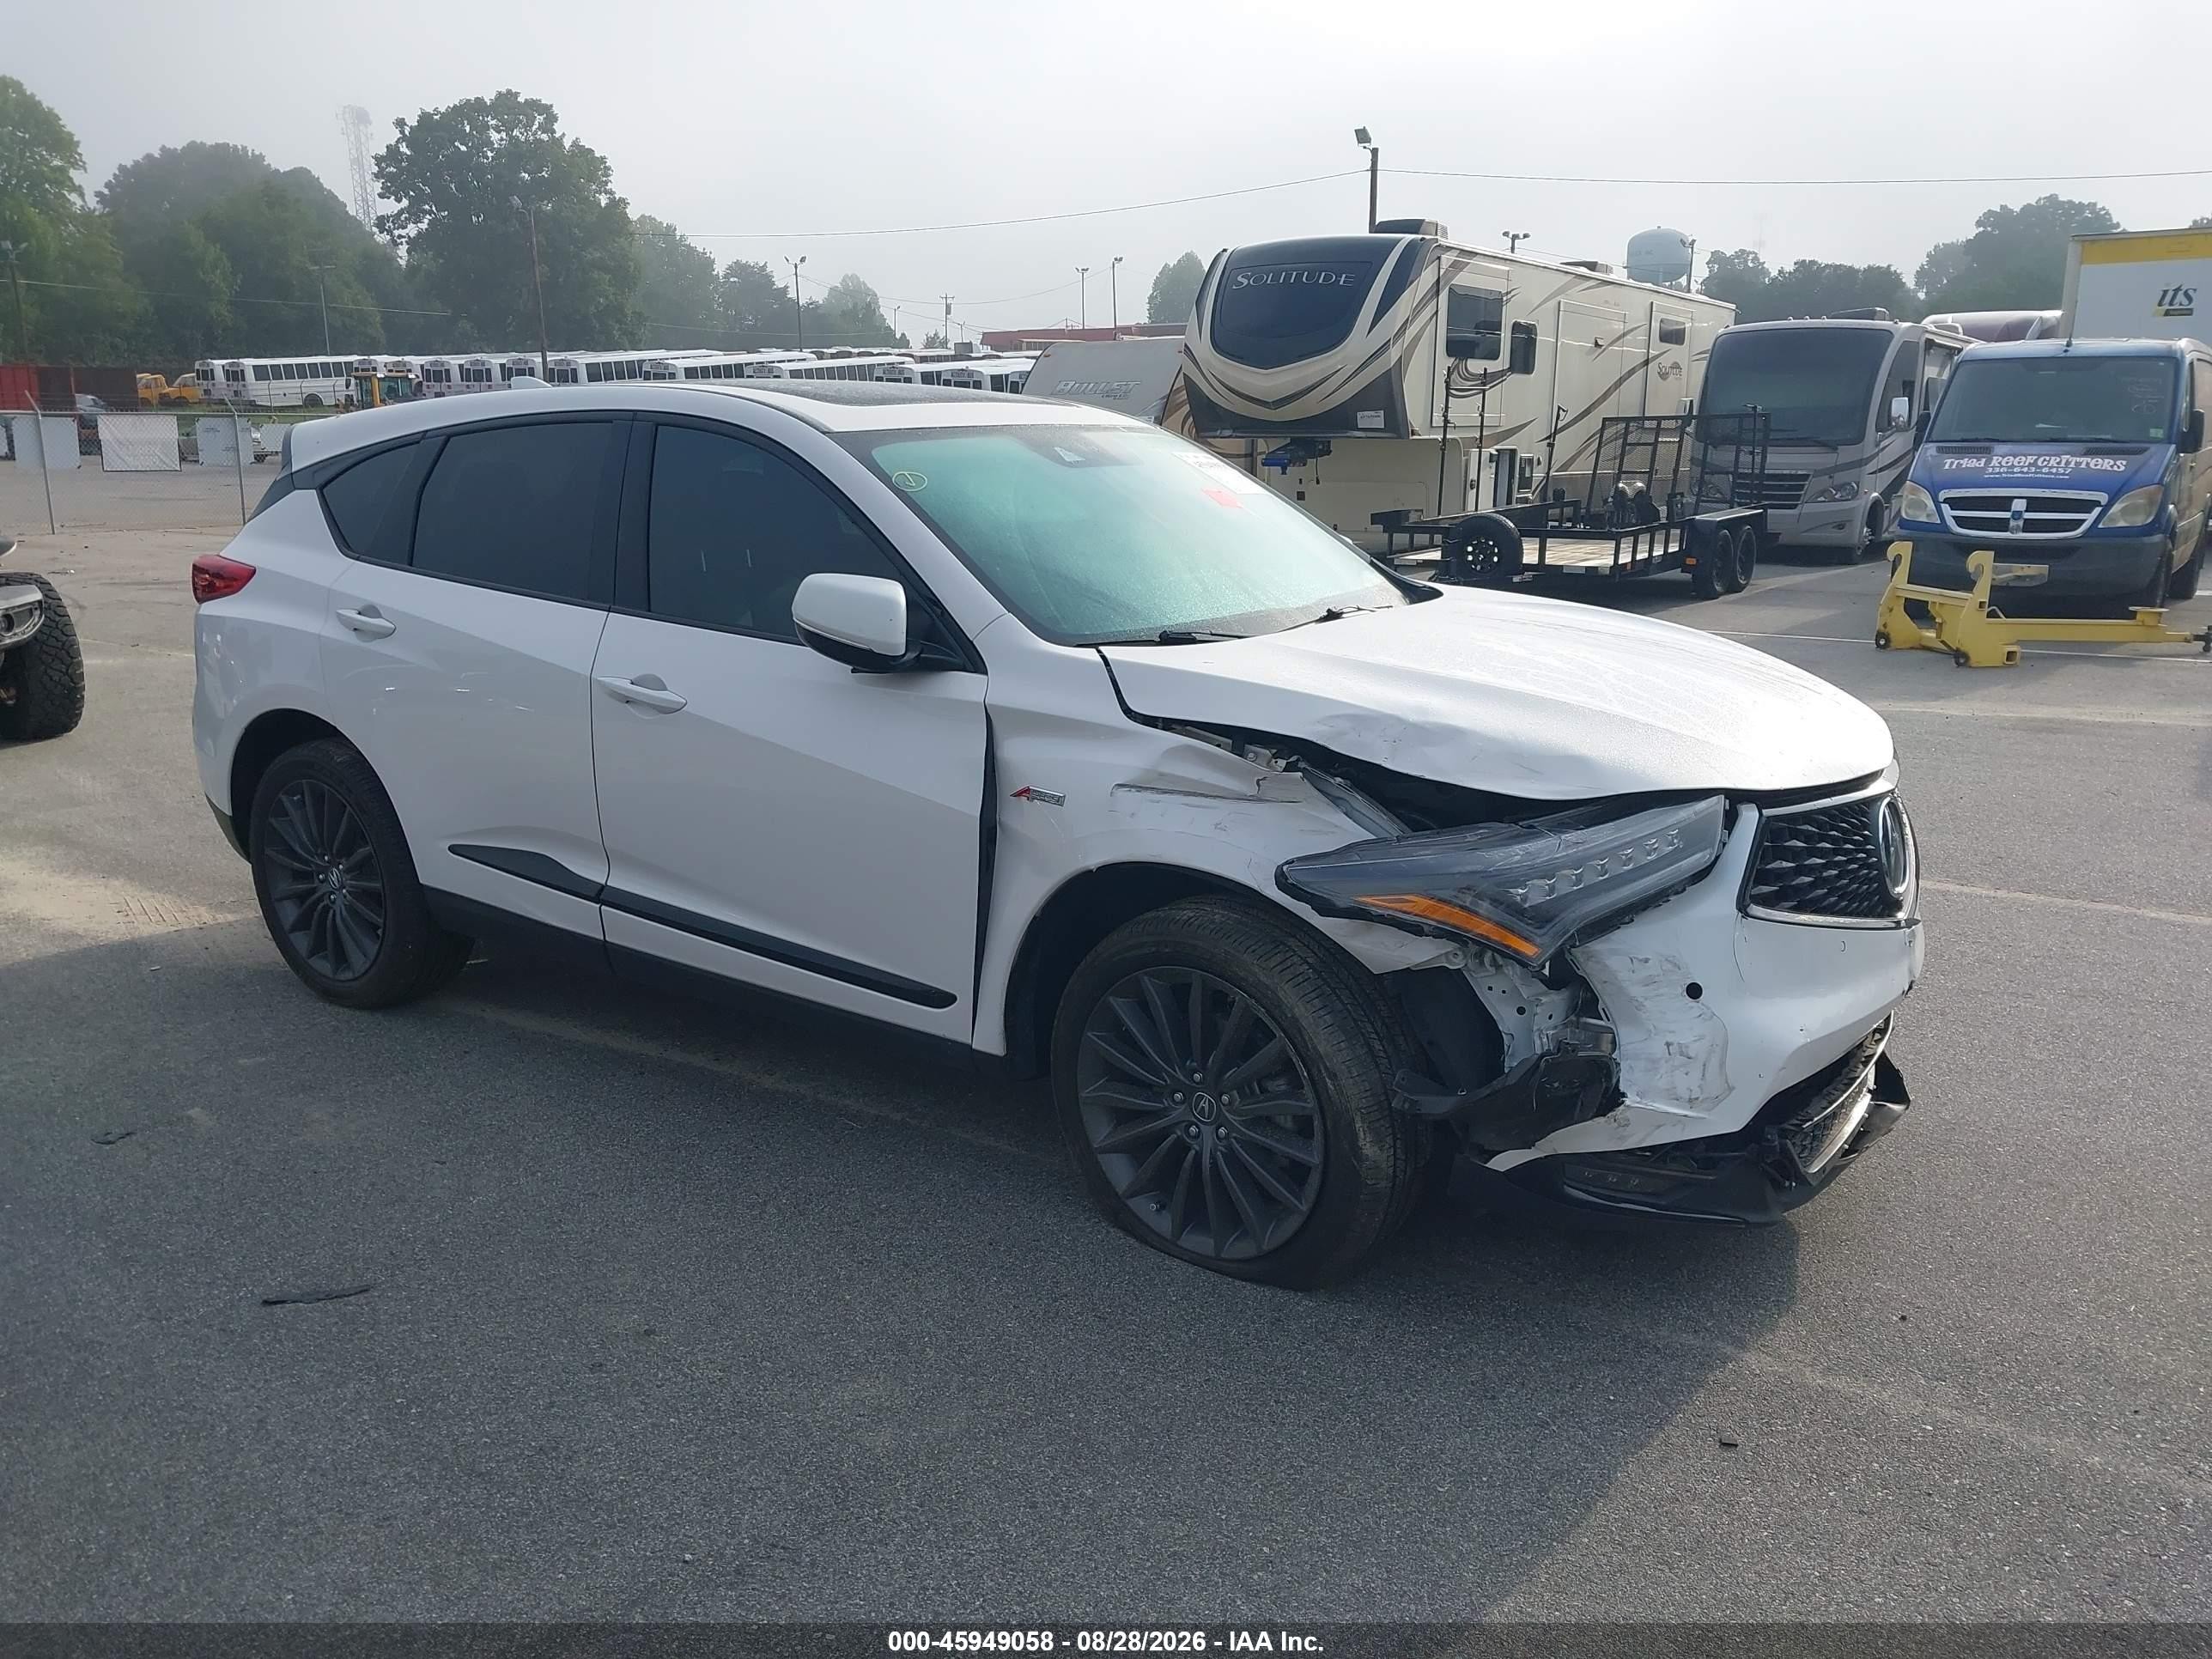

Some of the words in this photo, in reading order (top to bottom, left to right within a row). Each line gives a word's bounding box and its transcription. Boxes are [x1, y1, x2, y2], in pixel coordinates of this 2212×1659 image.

[1232, 270, 1356, 289] SOLITUDE
[2156, 284, 2197, 307] its
[1051, 380, 1140, 395] BULLET
[1943, 458, 1985, 470] Triad
